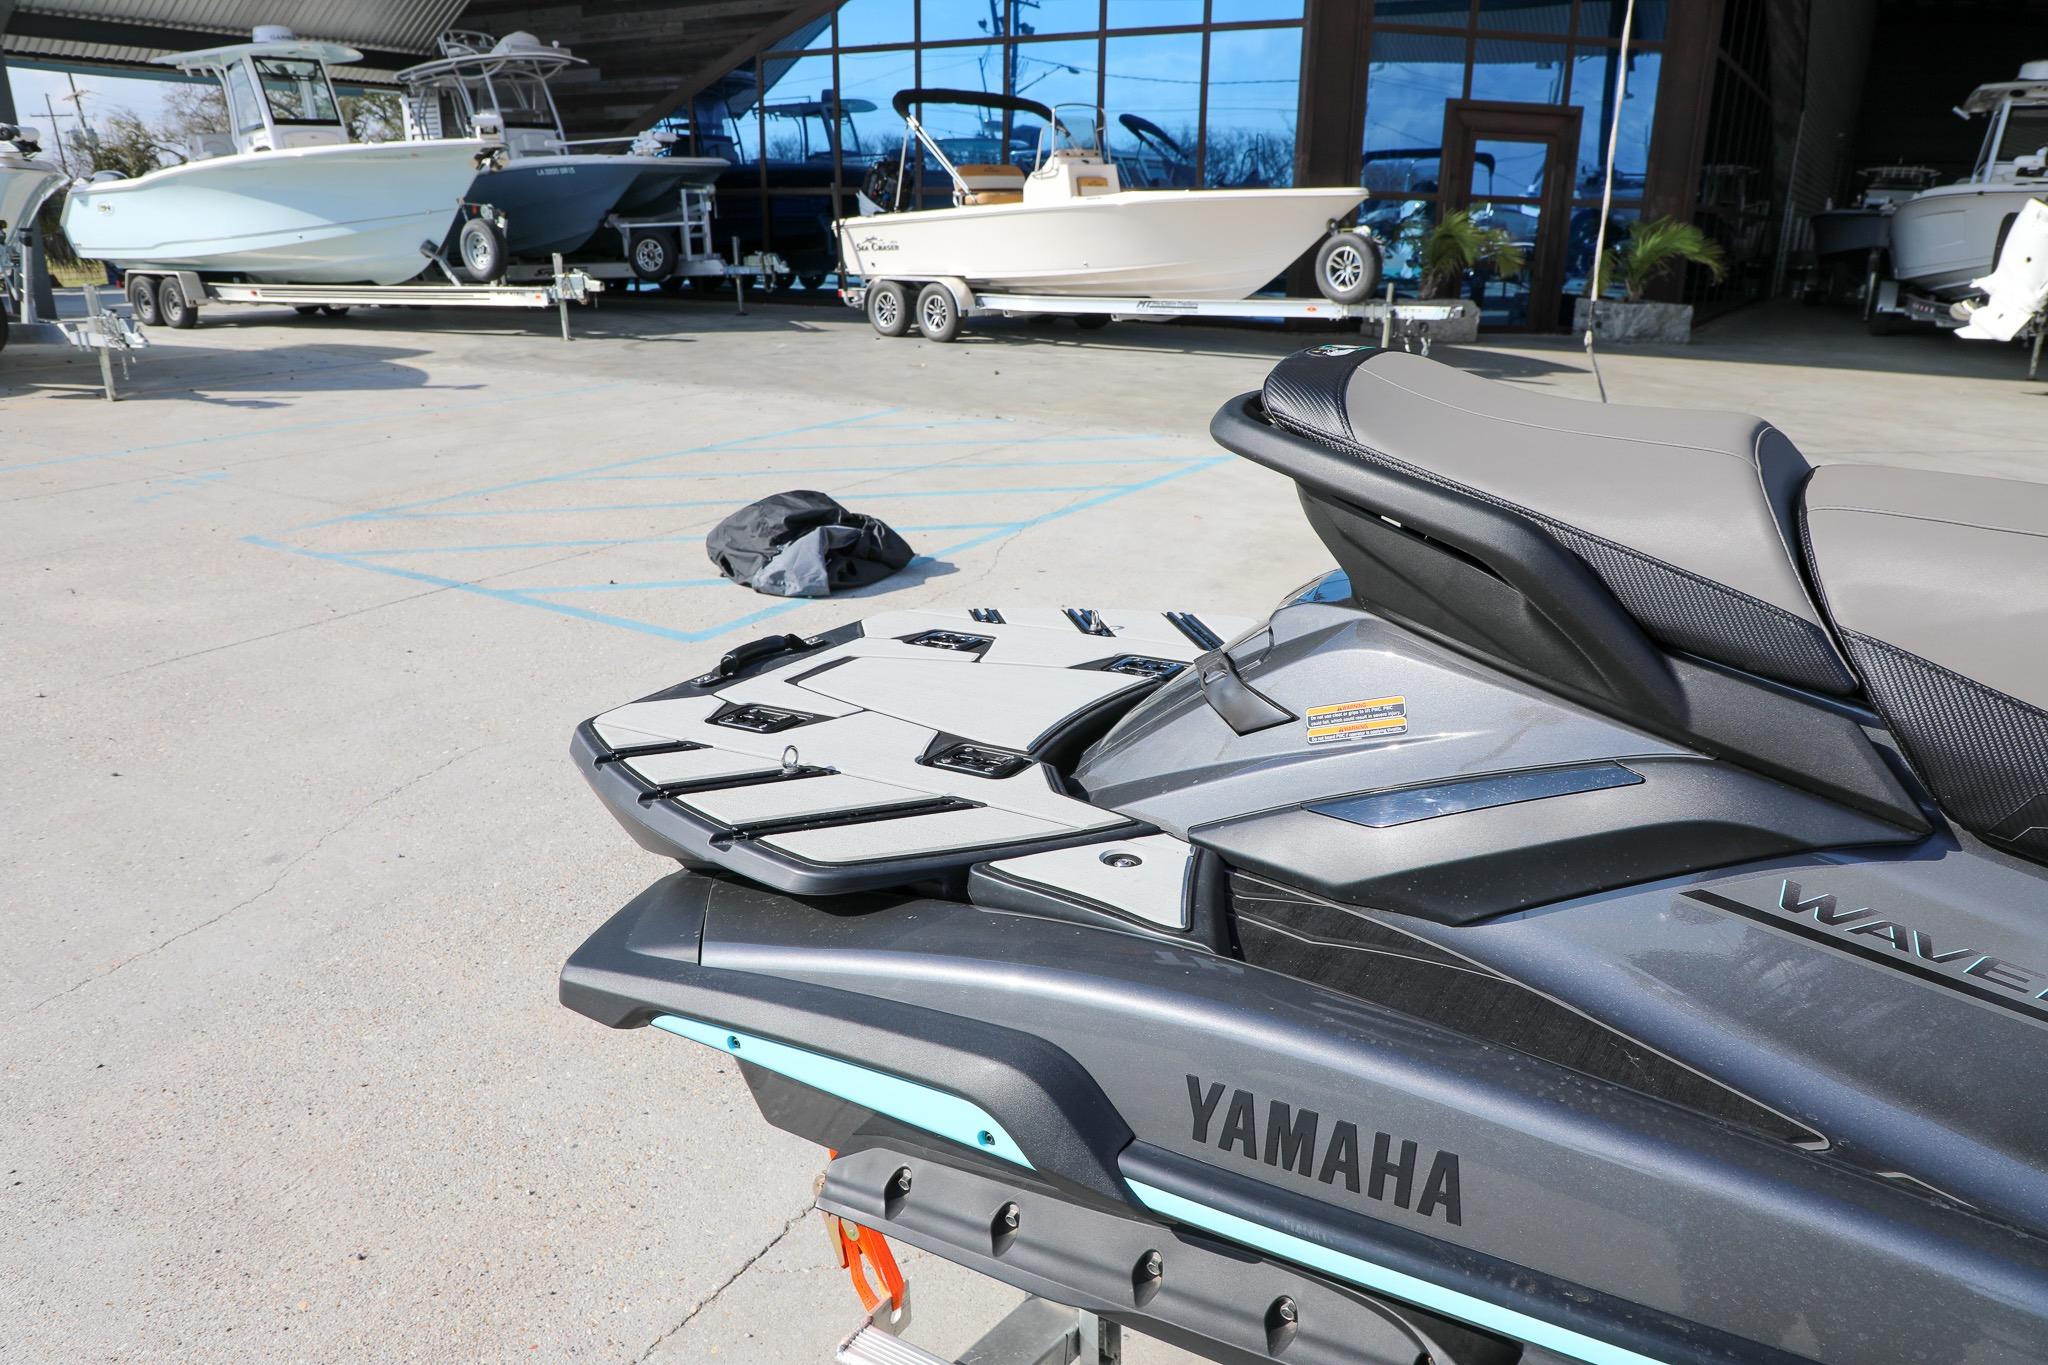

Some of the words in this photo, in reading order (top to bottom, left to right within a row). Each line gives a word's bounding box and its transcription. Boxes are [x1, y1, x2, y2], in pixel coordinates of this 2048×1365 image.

[1343, 703, 1367, 711] WARNING
[1344, 724, 1369, 732] WARNING
[1779, 879, 2048, 998] WAVE
[1186, 1074, 1461, 1226] YAMAHA
